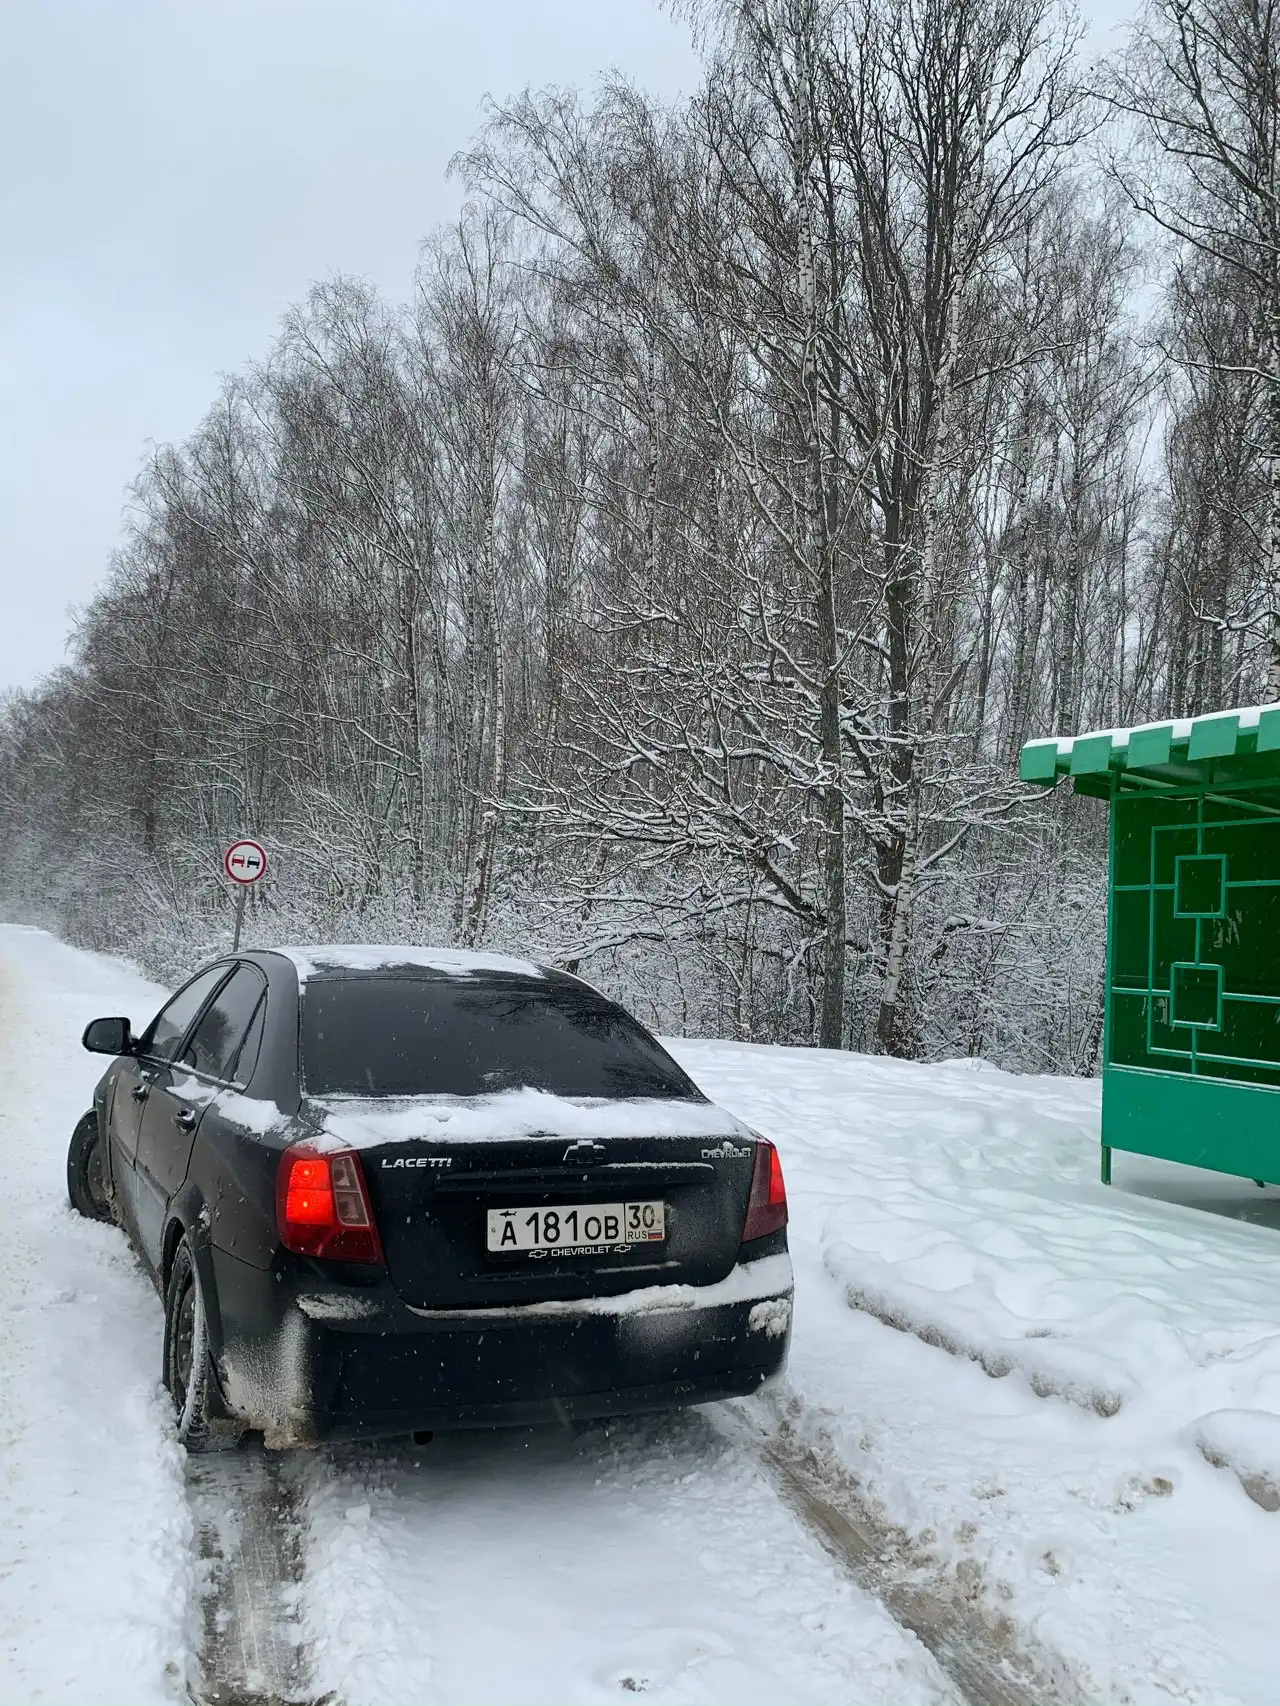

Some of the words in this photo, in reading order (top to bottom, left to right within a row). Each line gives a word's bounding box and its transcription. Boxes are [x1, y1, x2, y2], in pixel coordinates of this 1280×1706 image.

[381, 1157, 452, 1168] LACETTI
[628, 1205, 656, 1229] 30
[627, 1230, 648, 1240] RUS
[550, 1245, 611, 1257] CHEVROLET
